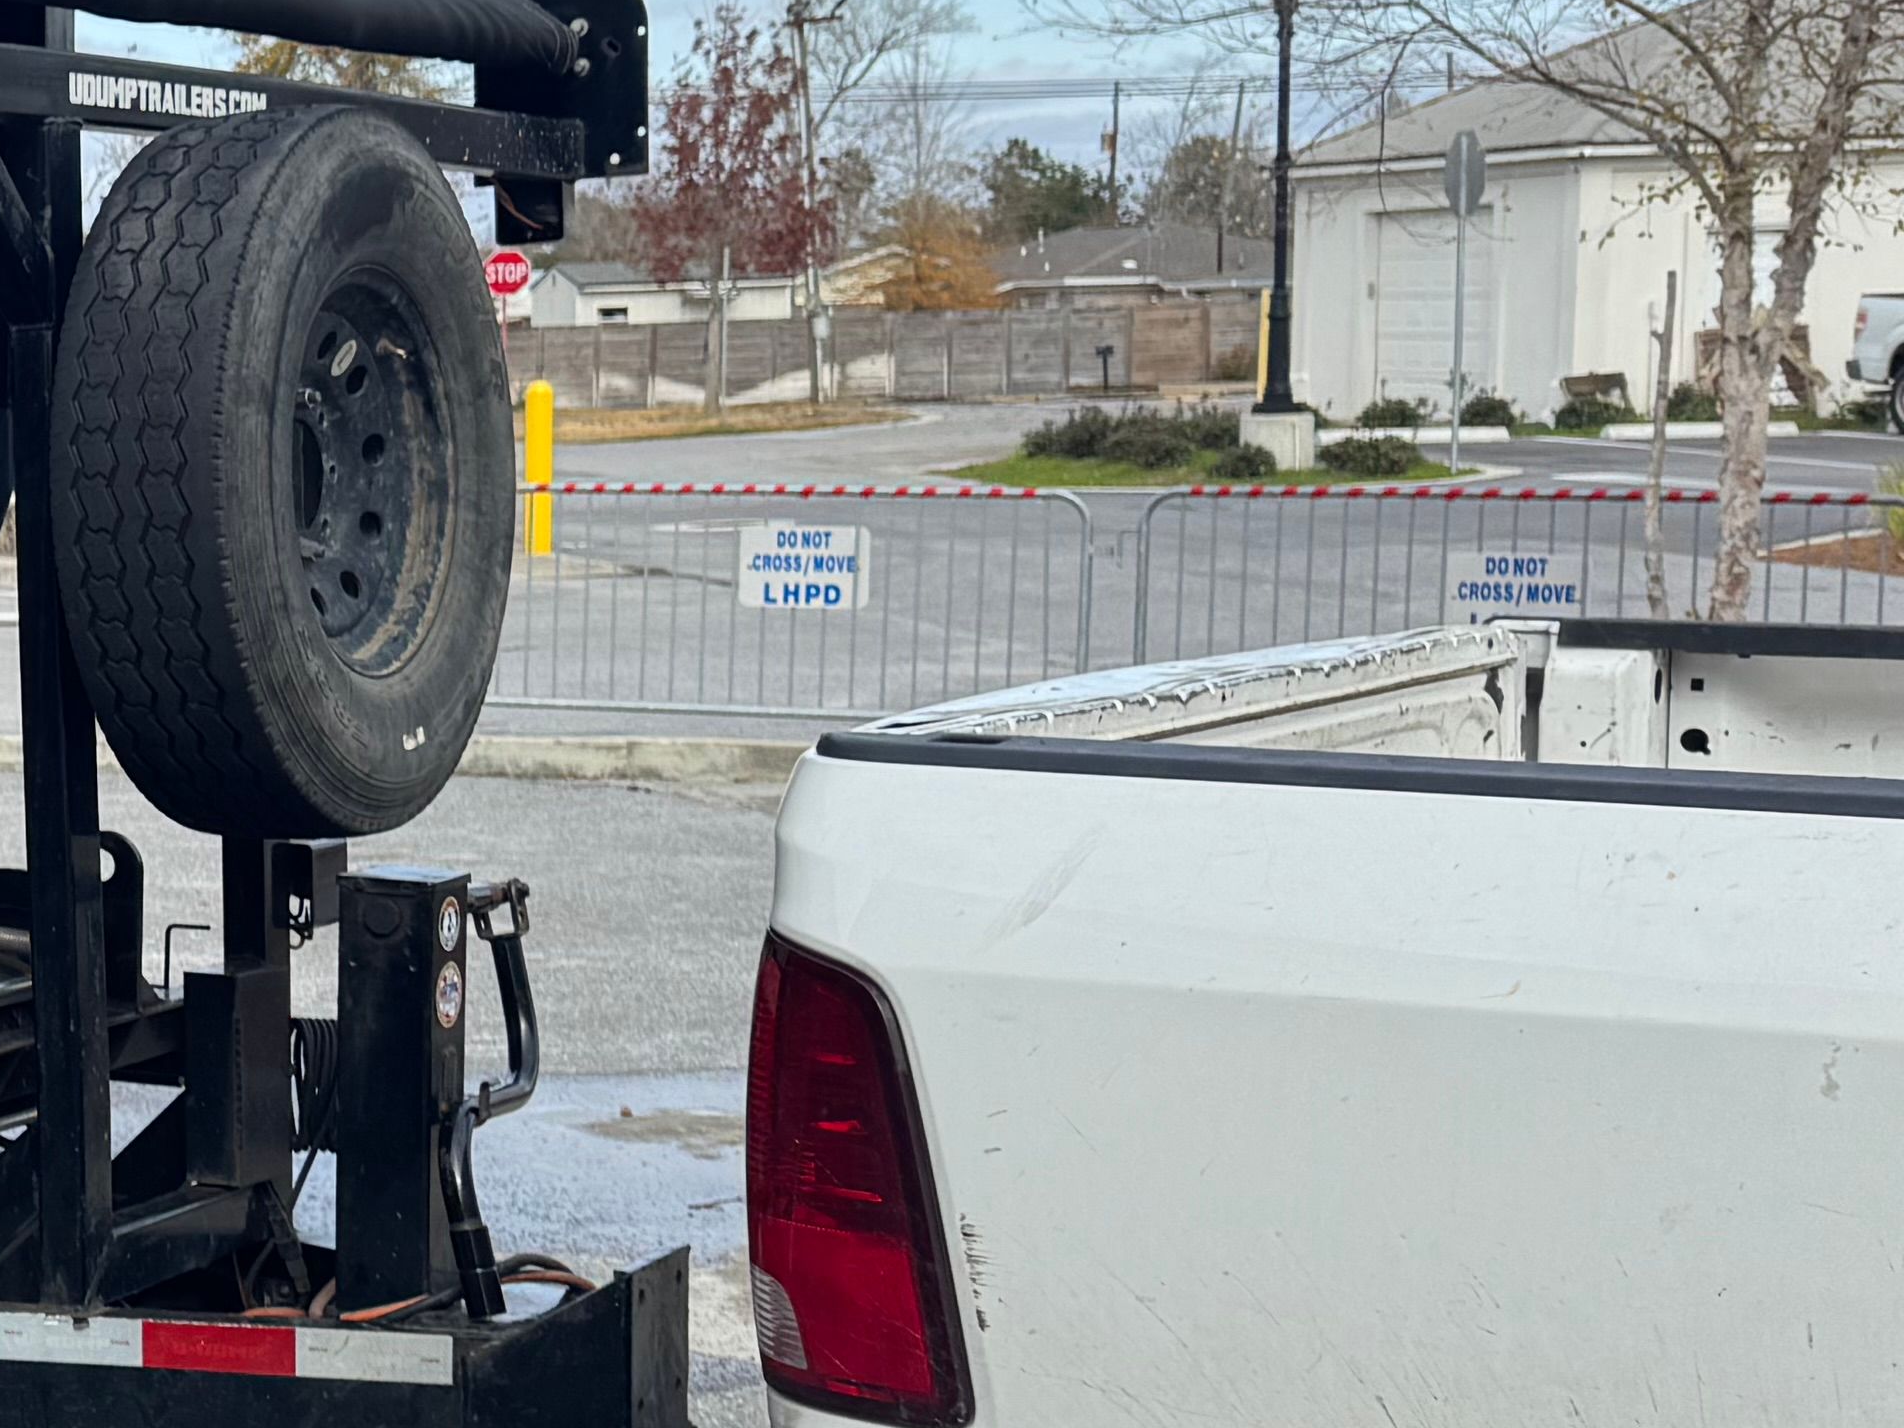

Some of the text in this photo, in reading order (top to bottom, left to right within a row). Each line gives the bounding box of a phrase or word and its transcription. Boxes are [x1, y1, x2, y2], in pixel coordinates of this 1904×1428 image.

[485, 262, 527, 284] STOP
[776, 530, 833, 550] DO NOT
[752, 553, 857, 577] CROSS/MOVE
[1485, 556, 1548, 578] DO NOT
[763, 581, 842, 605] LHPD
[1457, 580, 1576, 607] CROSS/MOVE
